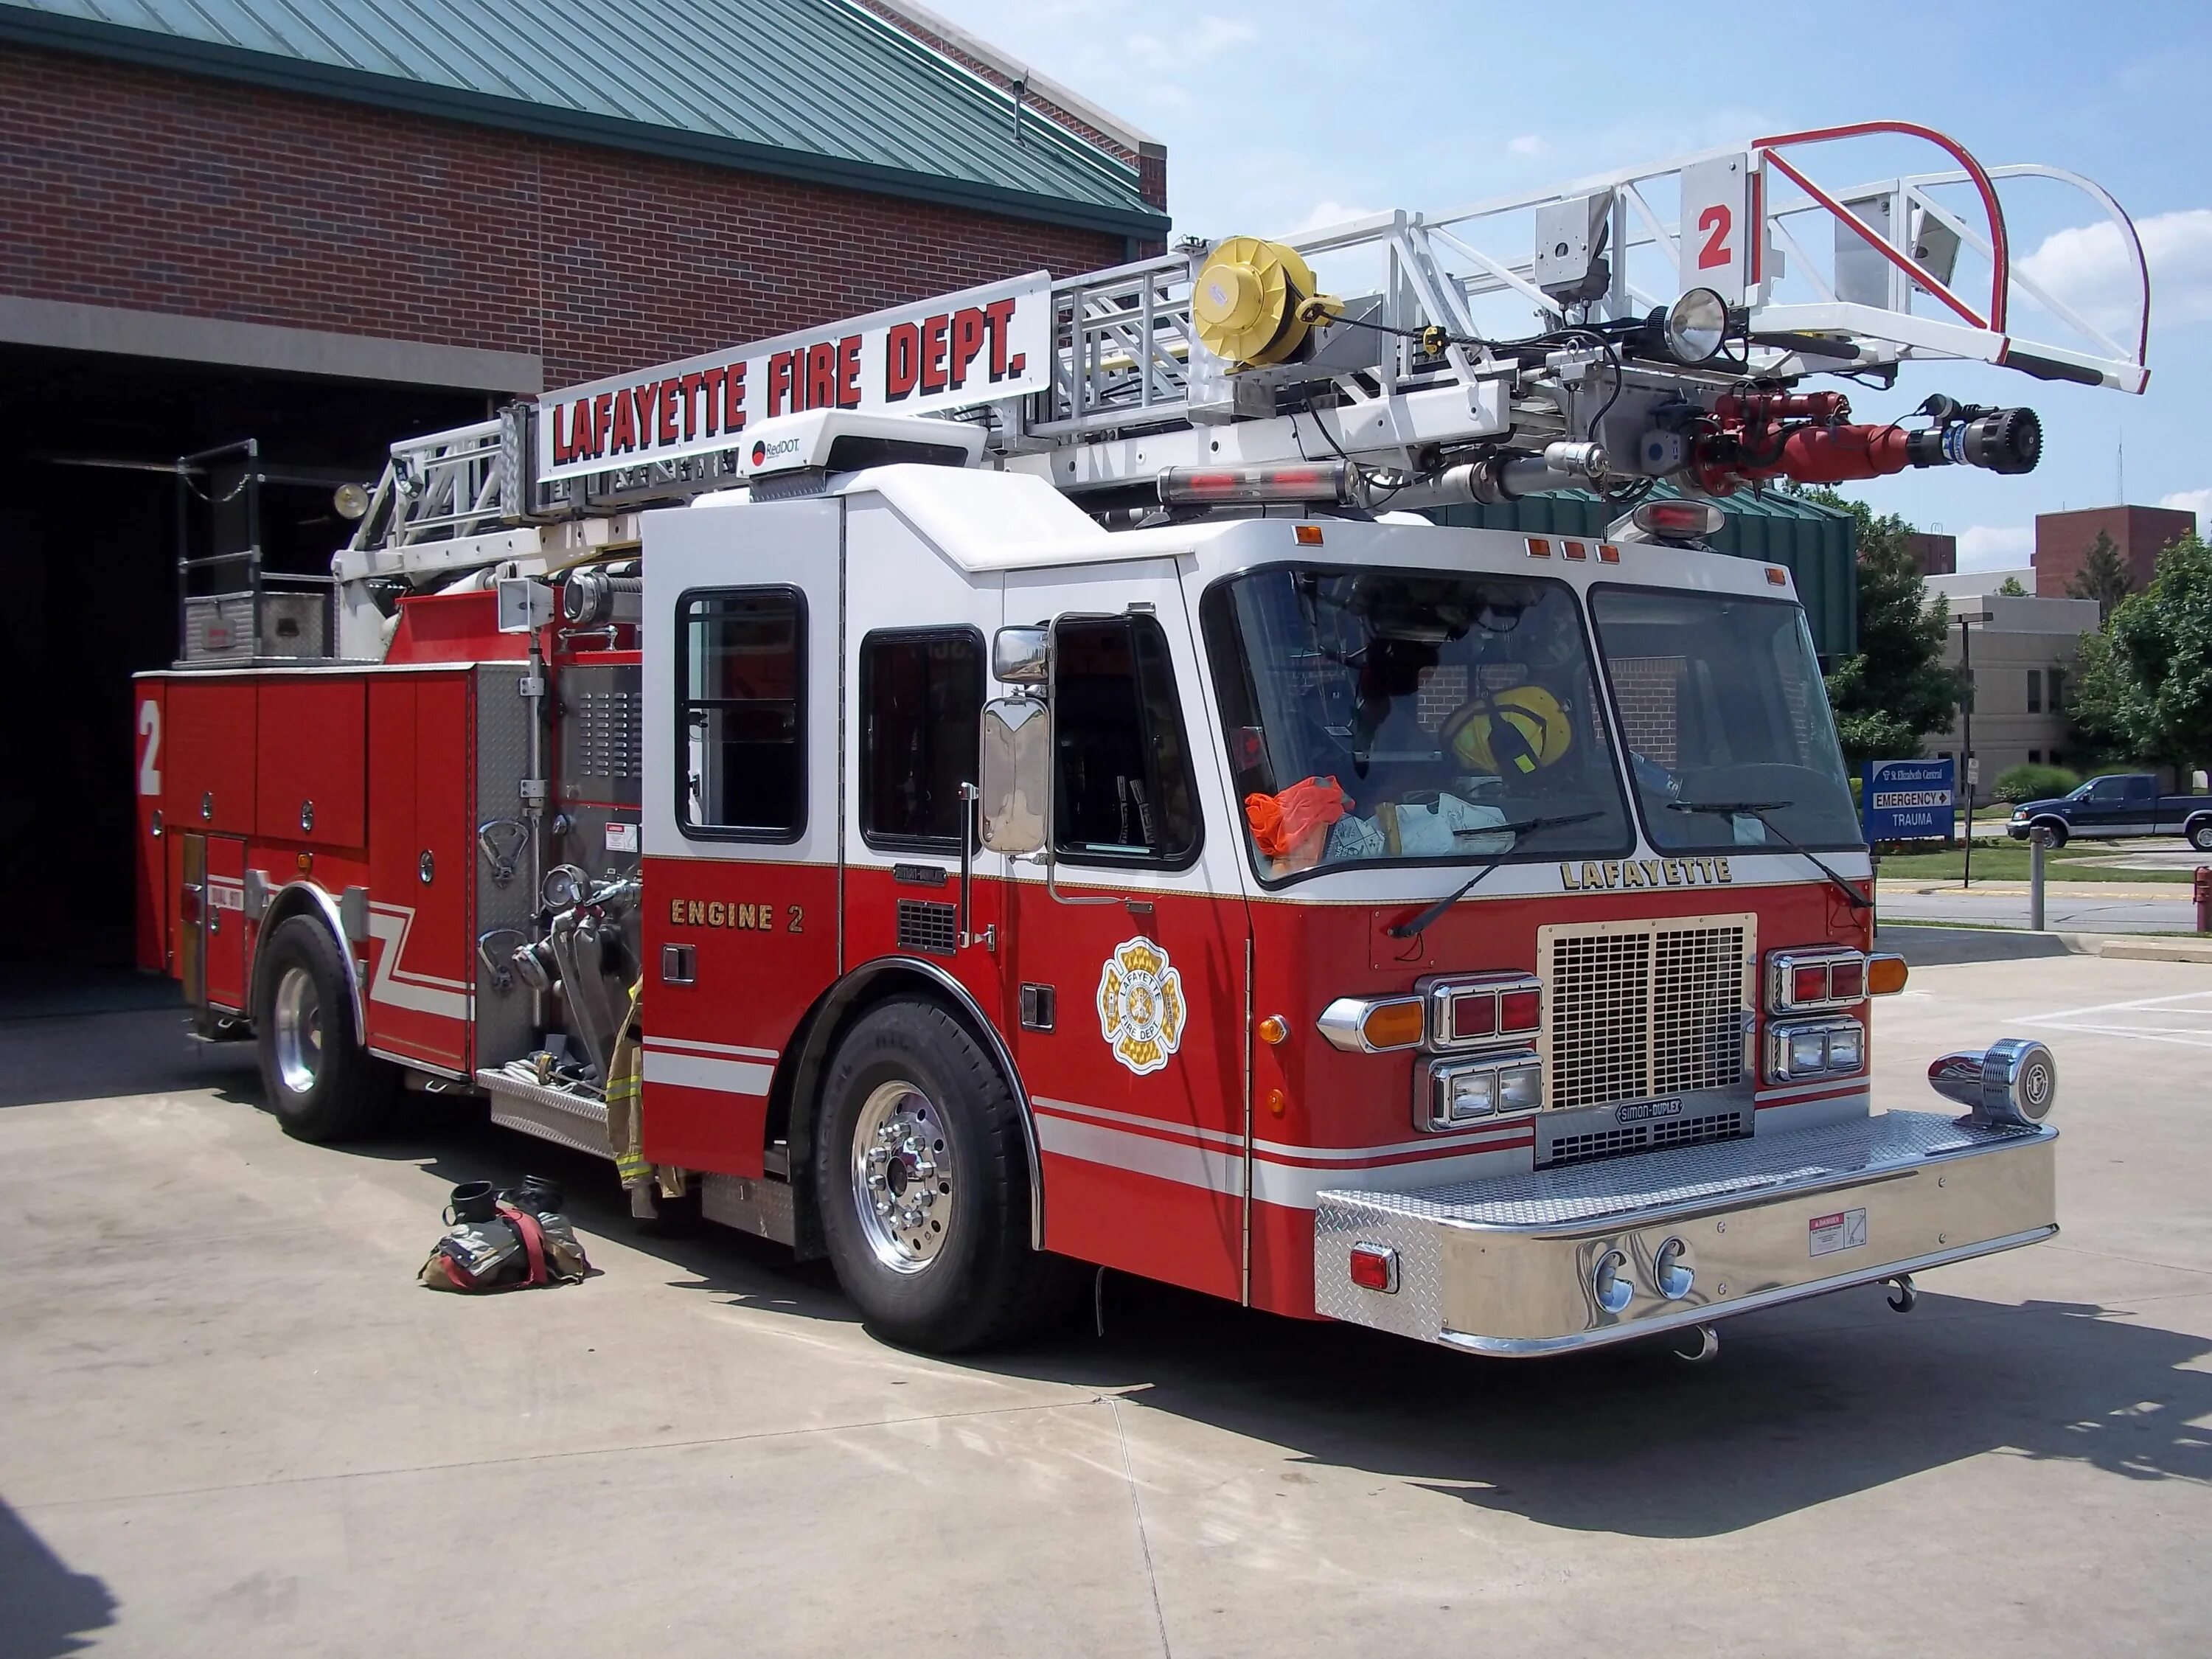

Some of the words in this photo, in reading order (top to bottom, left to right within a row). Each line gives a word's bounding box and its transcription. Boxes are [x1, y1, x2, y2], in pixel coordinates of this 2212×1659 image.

[1698, 204, 1732, 270] 2
[553, 361, 748, 467] LAFAYETTE
[768, 334, 863, 418] FIRE
[886, 298, 1026, 403] DEPT.
[766, 438, 800, 456] RedDOT
[139, 700, 161, 796] 2
[1877, 792, 1937, 807] EMERGENCY
[1893, 813, 1933, 827] TRAUMA
[1559, 857, 1733, 890] LAFAYETTE
[671, 898, 773, 931] ENGINE
[787, 905, 804, 933] 2
[1119, 971, 1162, 1001] LAFAYETTE
[1121, 1015, 1138, 1038] FIRE
